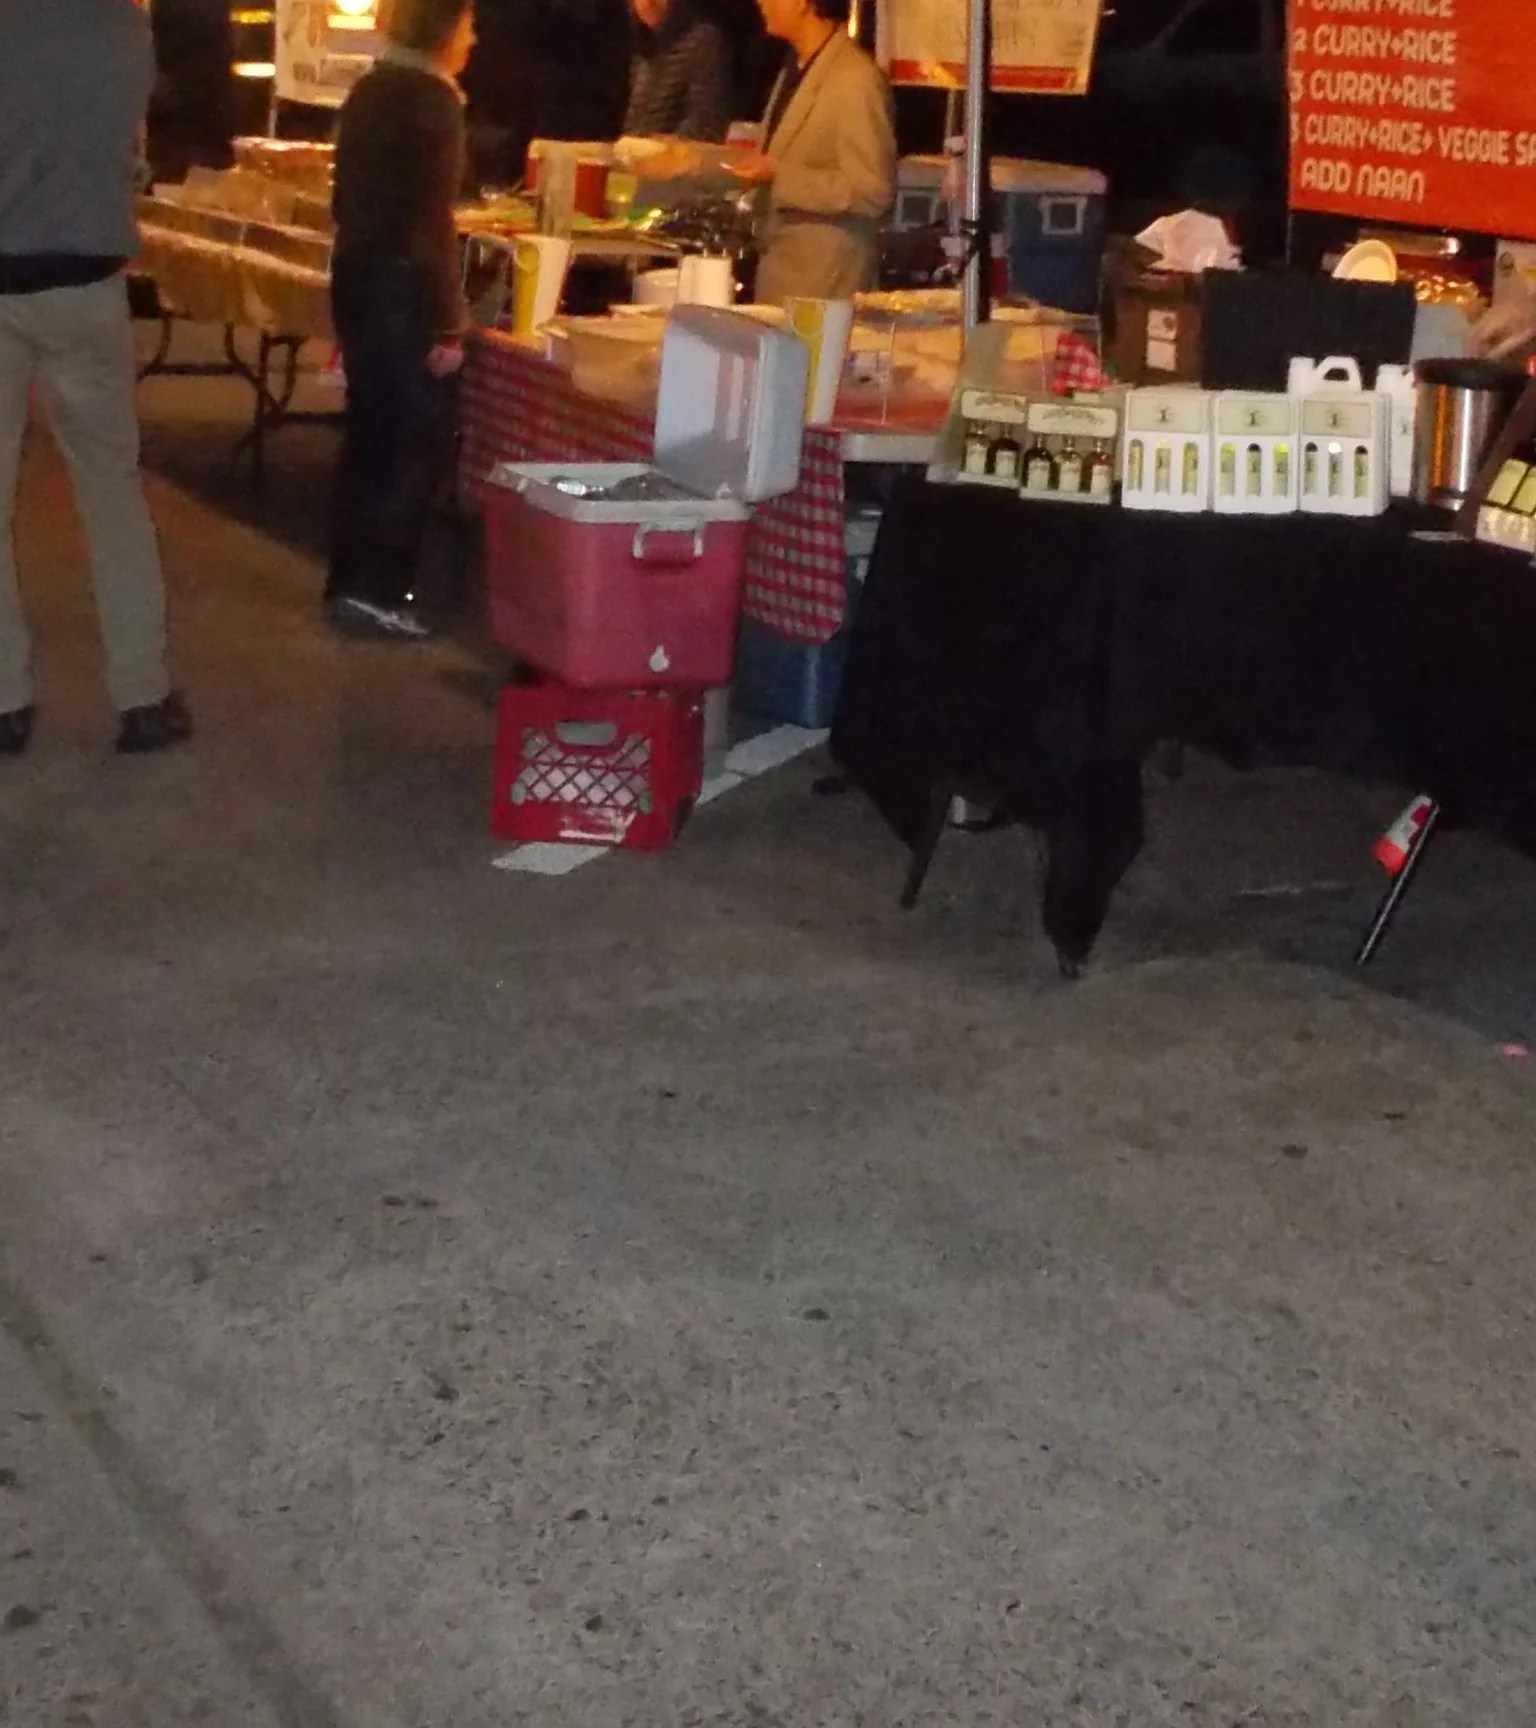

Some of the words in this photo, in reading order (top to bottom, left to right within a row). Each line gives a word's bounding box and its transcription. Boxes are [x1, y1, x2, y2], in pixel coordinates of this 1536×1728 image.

[1293, 27, 1308, 53] 2
[1313, 23, 1458, 66] CURRY+RICE
[1309, 68, 1457, 113] CURRY+RICE
[1438, 126, 1512, 165] VEGGIE
[1300, 156, 1352, 194] ADD
